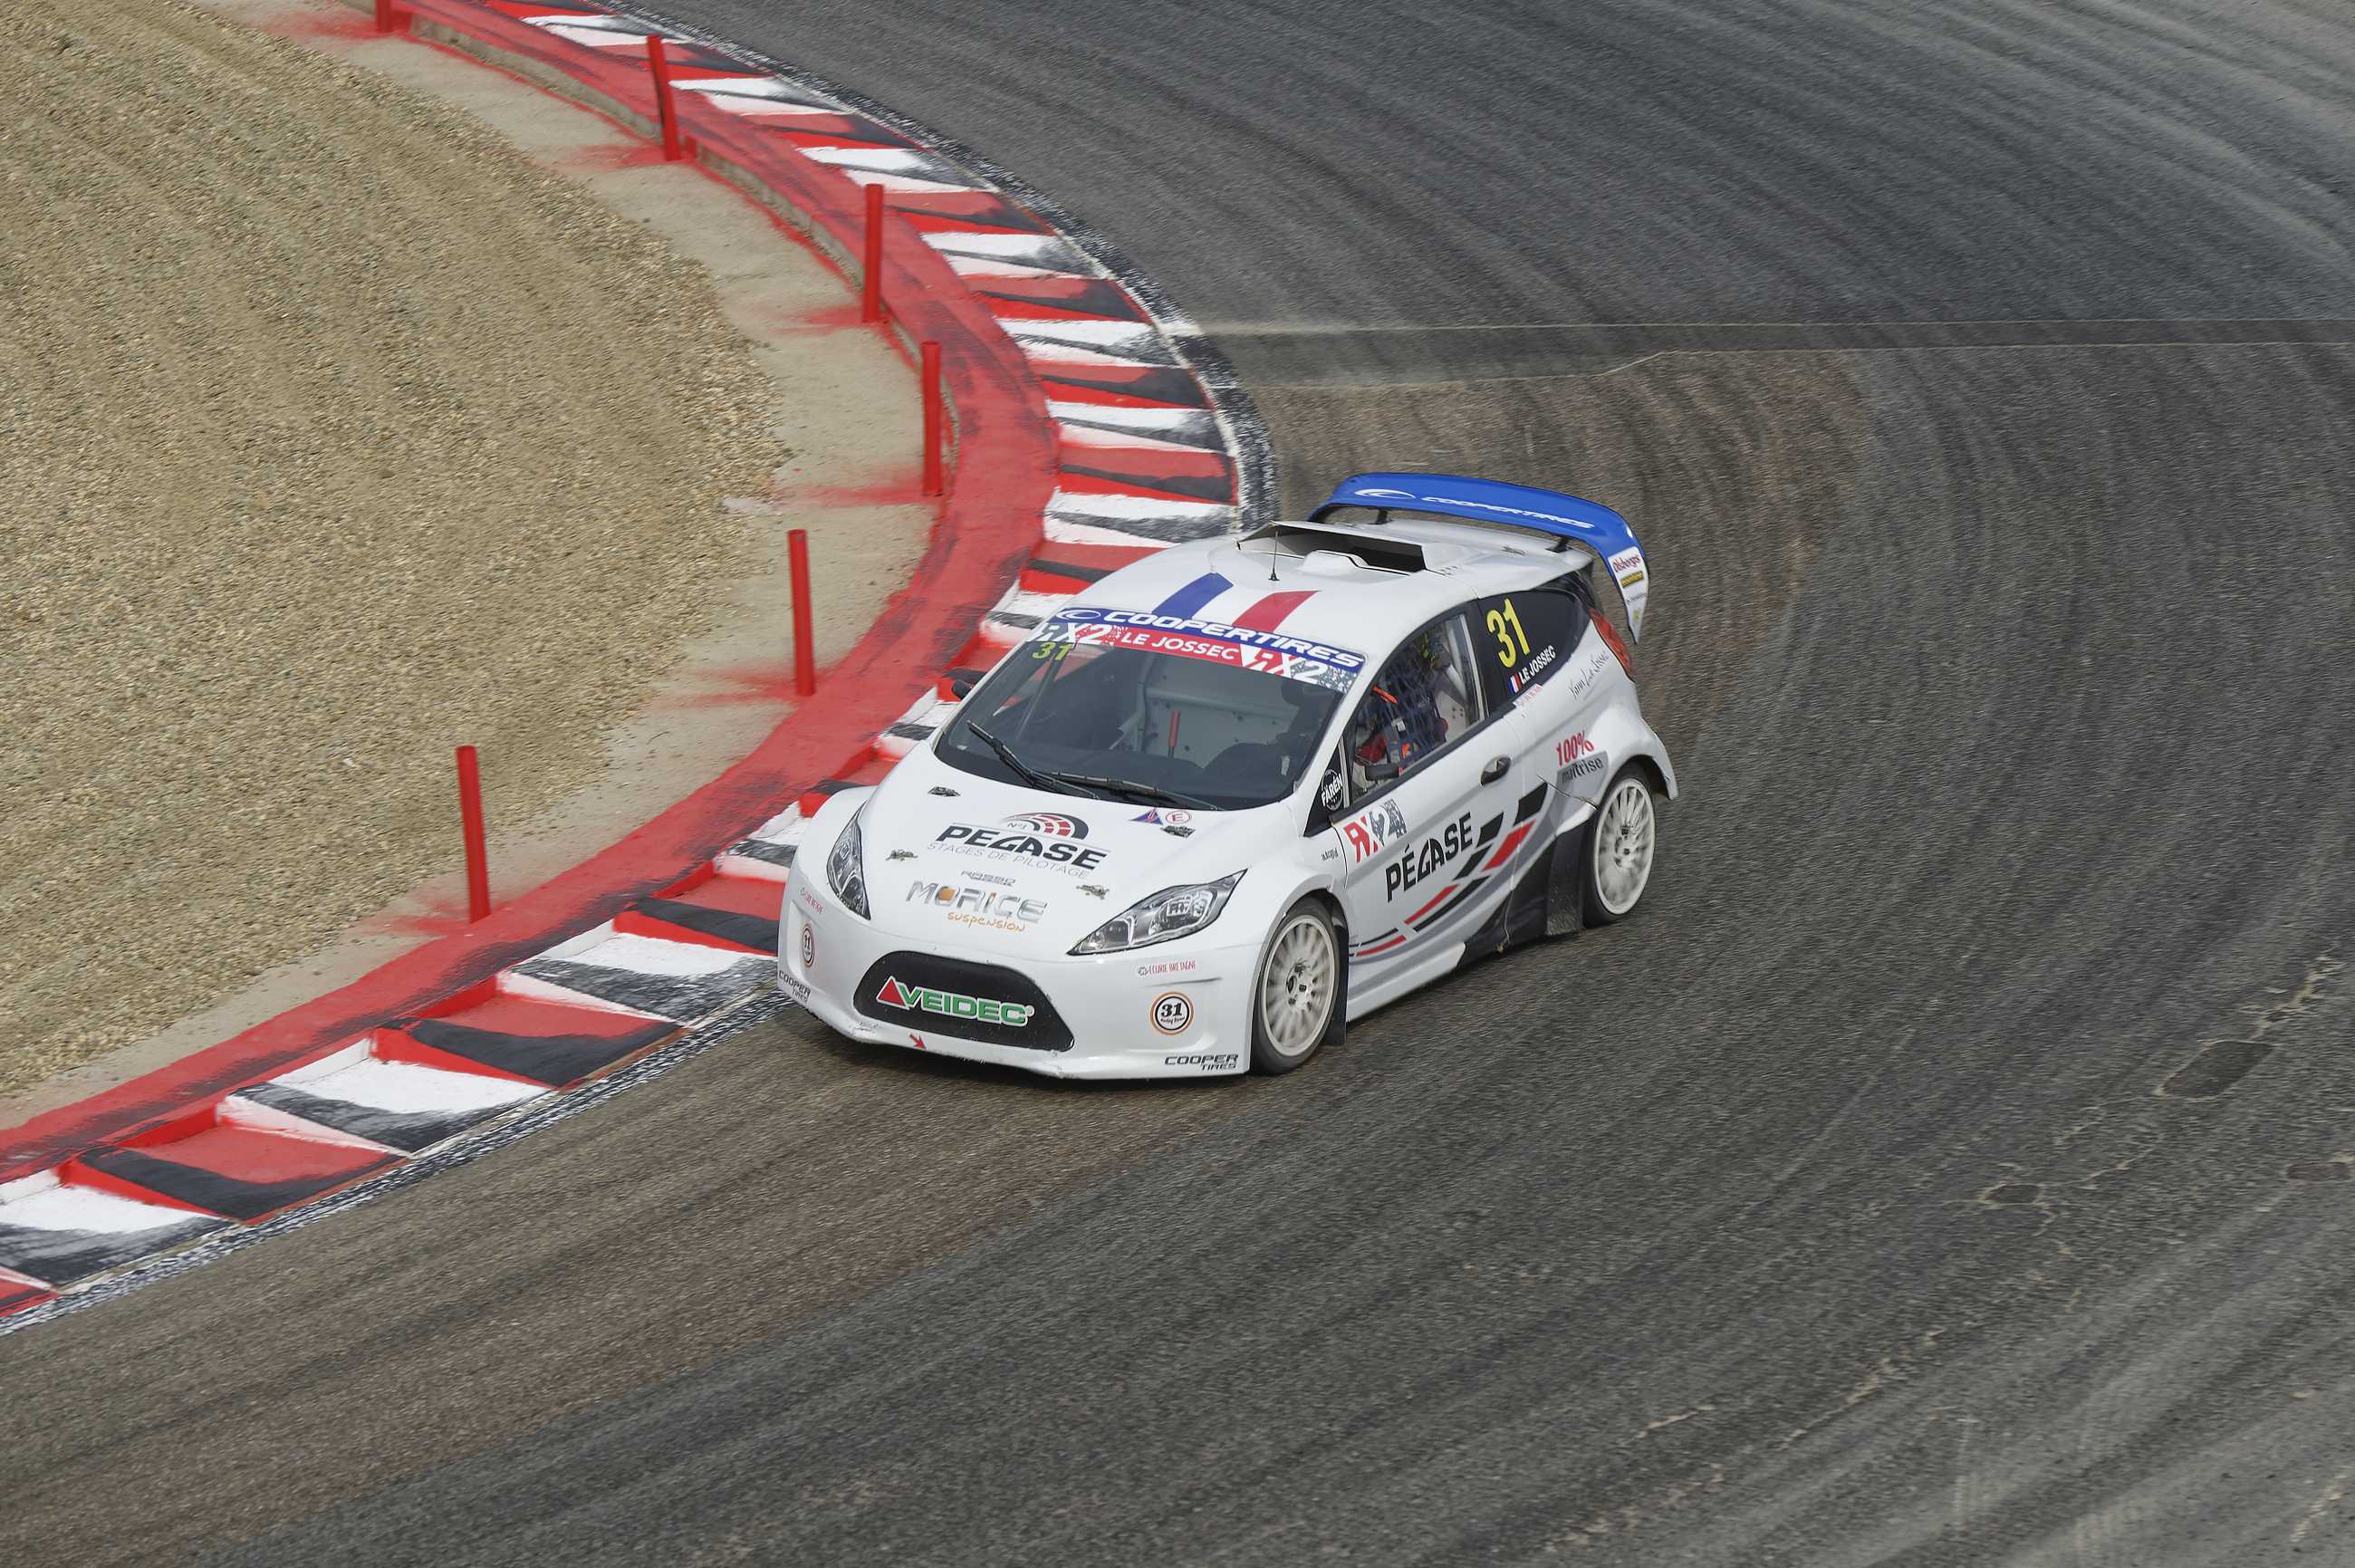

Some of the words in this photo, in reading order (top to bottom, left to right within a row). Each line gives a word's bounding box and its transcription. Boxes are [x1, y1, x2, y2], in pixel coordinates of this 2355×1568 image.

[1032, 641, 1073, 661] 31
[1121, 631, 1150, 645] LE
[1152, 637, 1240, 660] JOSSEC
[1486, 596, 1531, 669] 31
[1518, 667, 1531, 685] LE
[1529, 644, 1556, 677] JOSSEC
[1556, 730, 1594, 767] 100%
[927, 842, 984, 858] STAGES
[987, 850, 1009, 862] DE
[1013, 853, 1091, 879] PILOTAGE
[935, 824, 1108, 871] PEGASE
[1385, 811, 1474, 903] PÉGASE
[778, 969, 812, 996] COOPER
[1160, 1002, 1183, 1017] 31
[1164, 1053, 1239, 1065] COOPER
